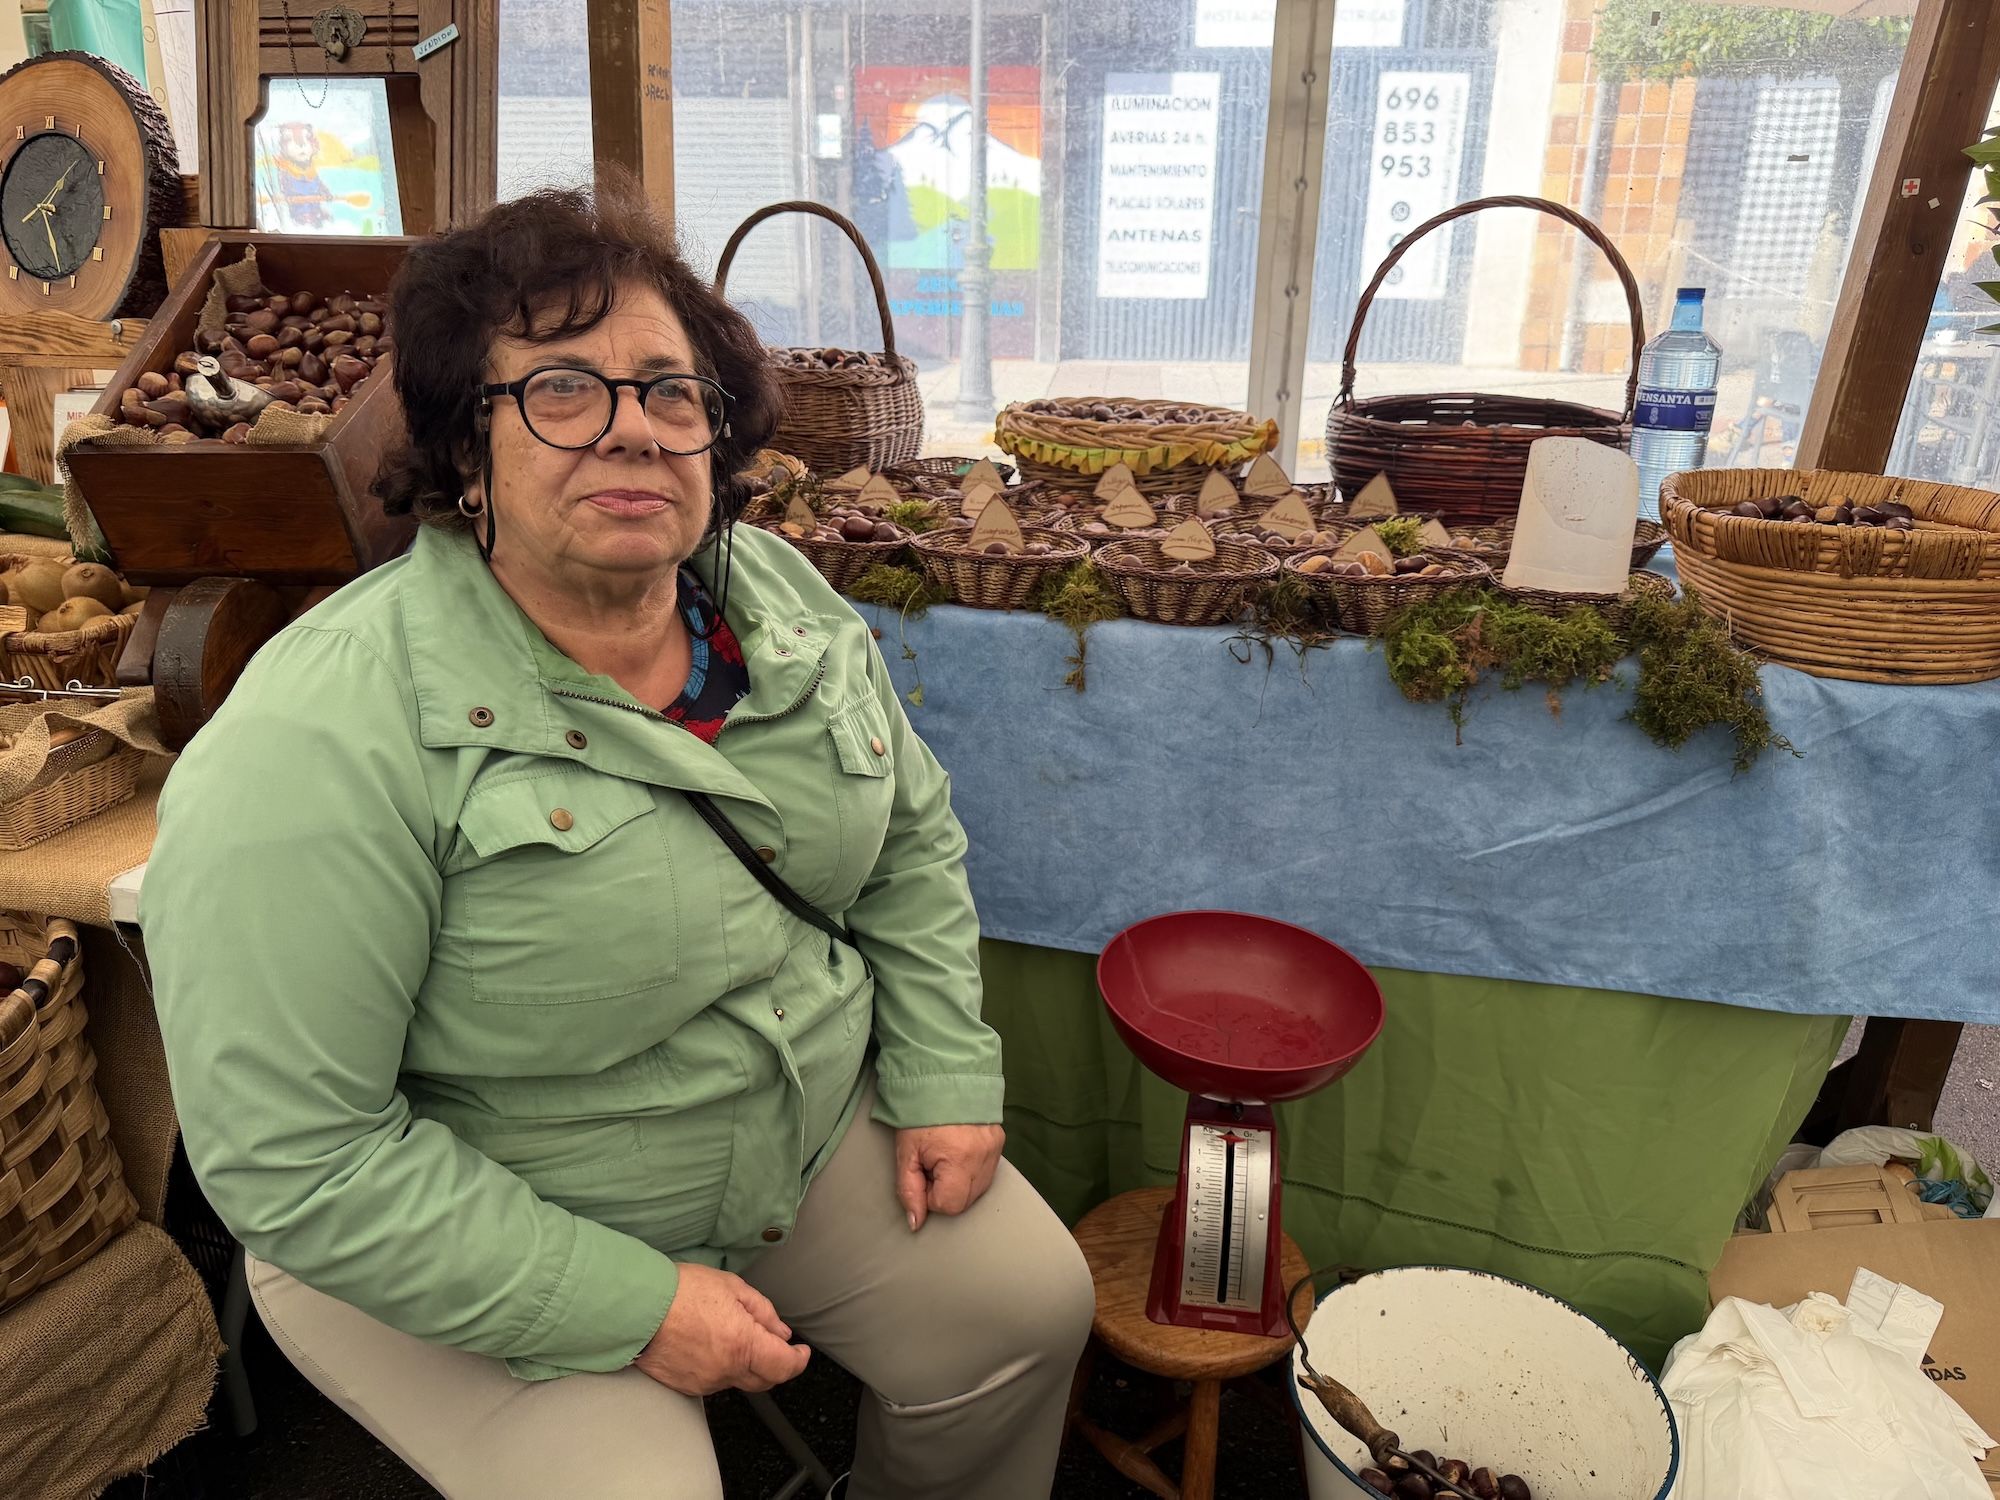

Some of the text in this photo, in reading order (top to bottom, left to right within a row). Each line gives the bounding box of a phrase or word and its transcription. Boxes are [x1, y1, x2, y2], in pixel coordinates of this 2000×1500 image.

[1386, 87, 1439, 110] 696
[1110, 131, 1166, 144] AVERIAS
[1173, 131, 1190, 144] 24
[1384, 121, 1435, 143] 853
[1381, 155, 1431, 178] 953
[1107, 229, 1201, 241] ANTENAS
